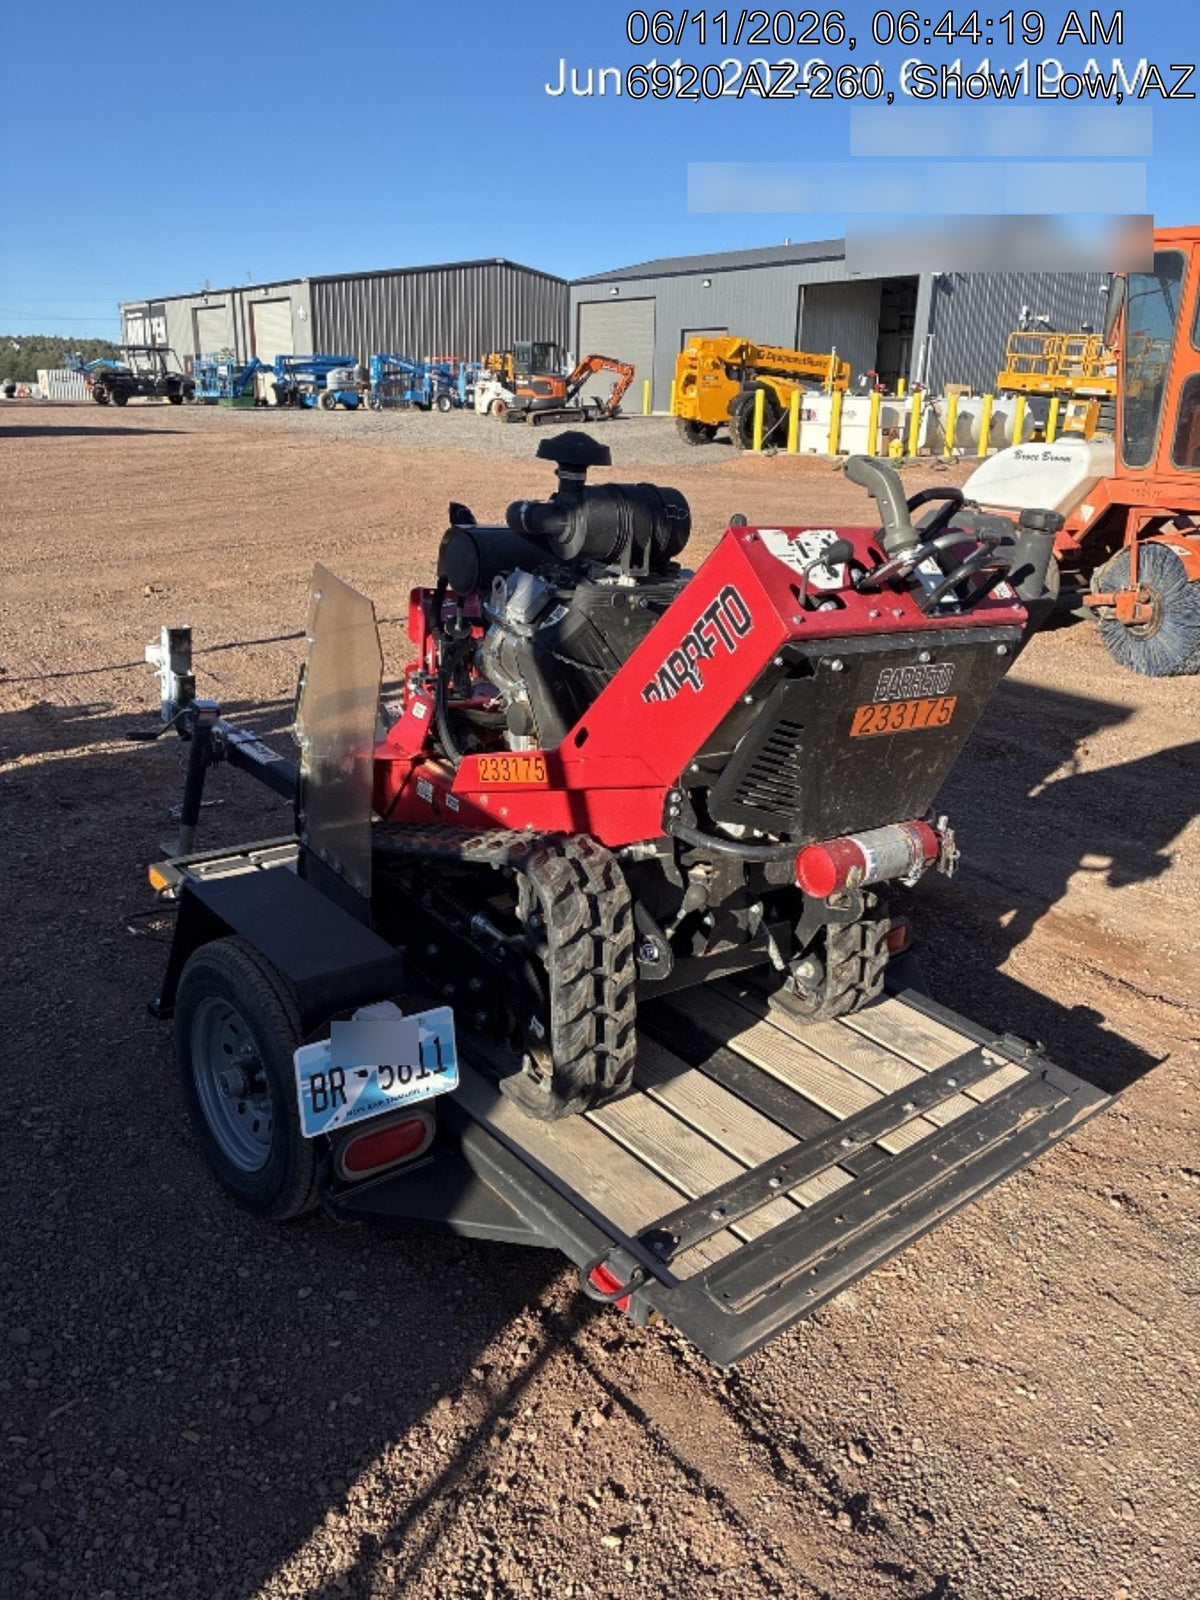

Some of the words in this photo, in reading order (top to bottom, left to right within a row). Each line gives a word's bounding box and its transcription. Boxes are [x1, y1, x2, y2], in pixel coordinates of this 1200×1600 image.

[873, 663, 956, 702] BARRETO
[858, 698, 954, 734] 233175
[479, 757, 546, 781] 233175
[309, 1066, 347, 1113] BR
